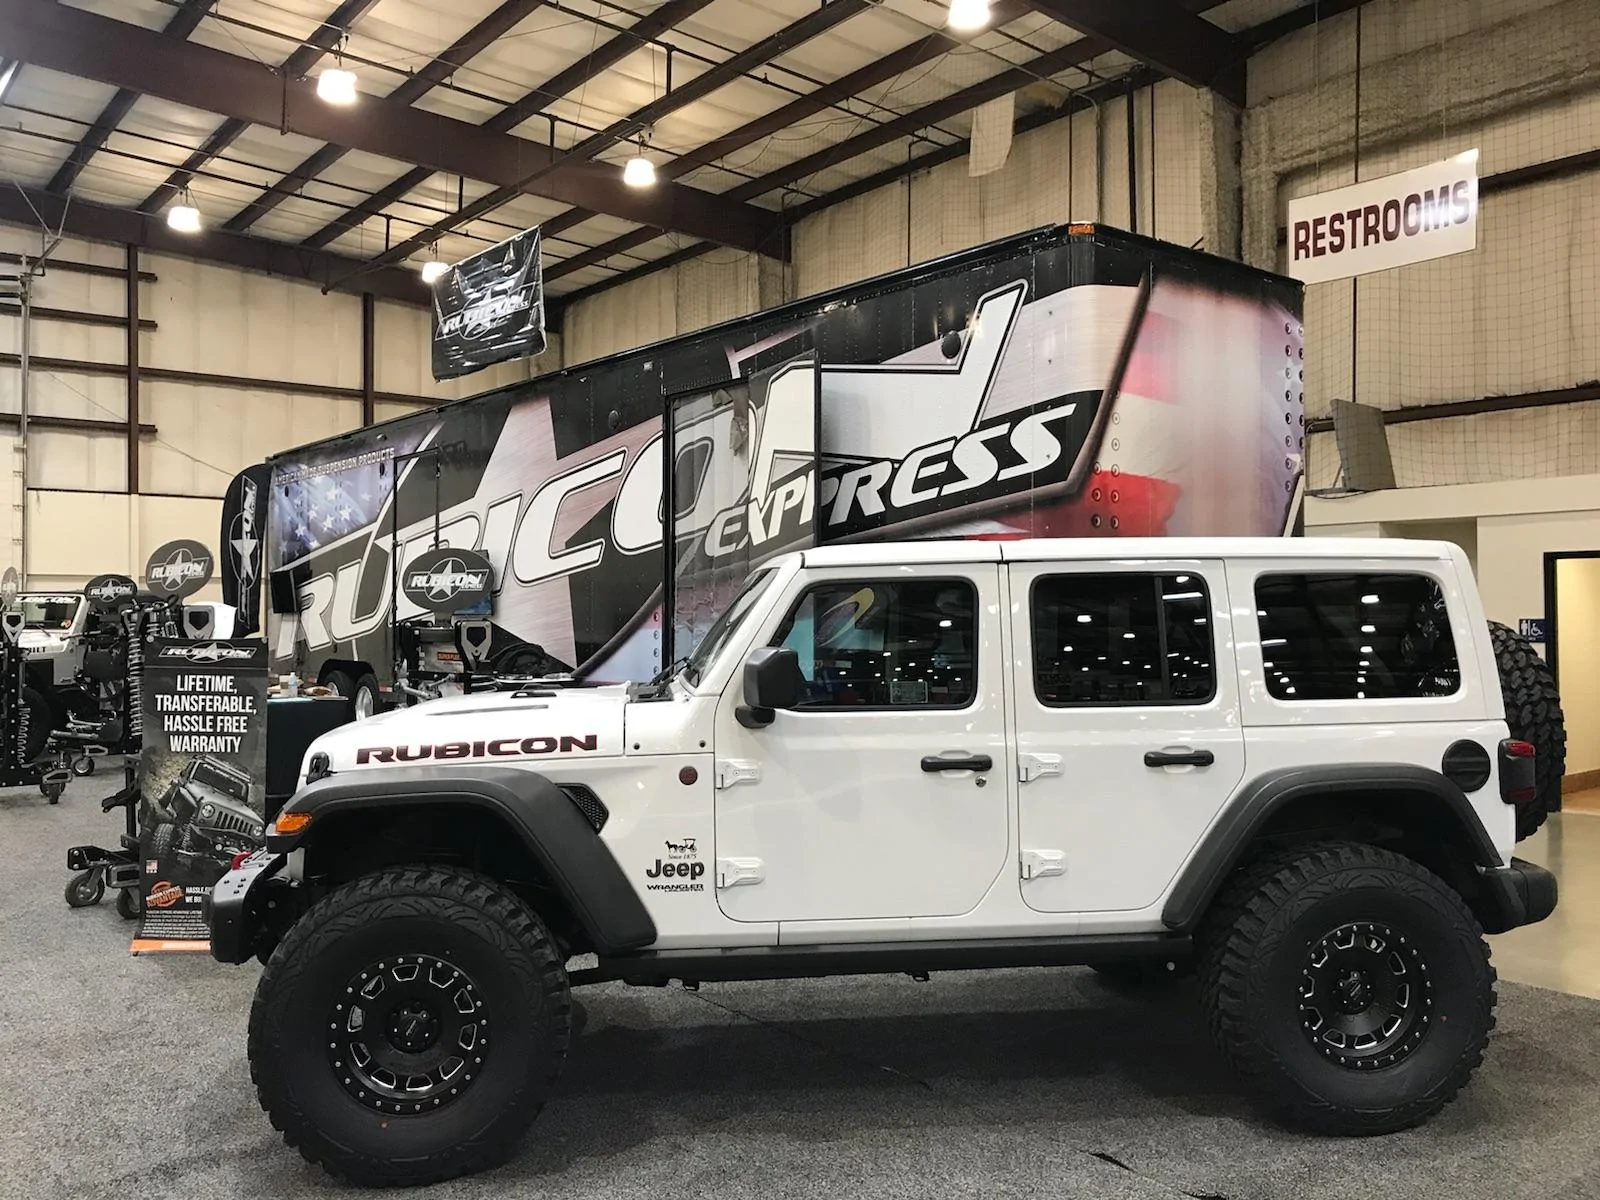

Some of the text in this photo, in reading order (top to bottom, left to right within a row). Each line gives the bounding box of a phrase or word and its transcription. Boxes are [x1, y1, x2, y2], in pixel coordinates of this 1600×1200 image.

[1294, 180, 1469, 261] RESTROOMS
[358, 447, 395, 466] PRODUCTS
[176, 675, 238, 694] LIFETIME,
[155, 694, 257, 715] TRANSFERABLE,
[164, 715, 248, 733] HASSLE FREE
[169, 735, 241, 753] WARRANTY
[356, 735, 598, 764] RUBICON
[646, 858, 704, 880] Jeep
